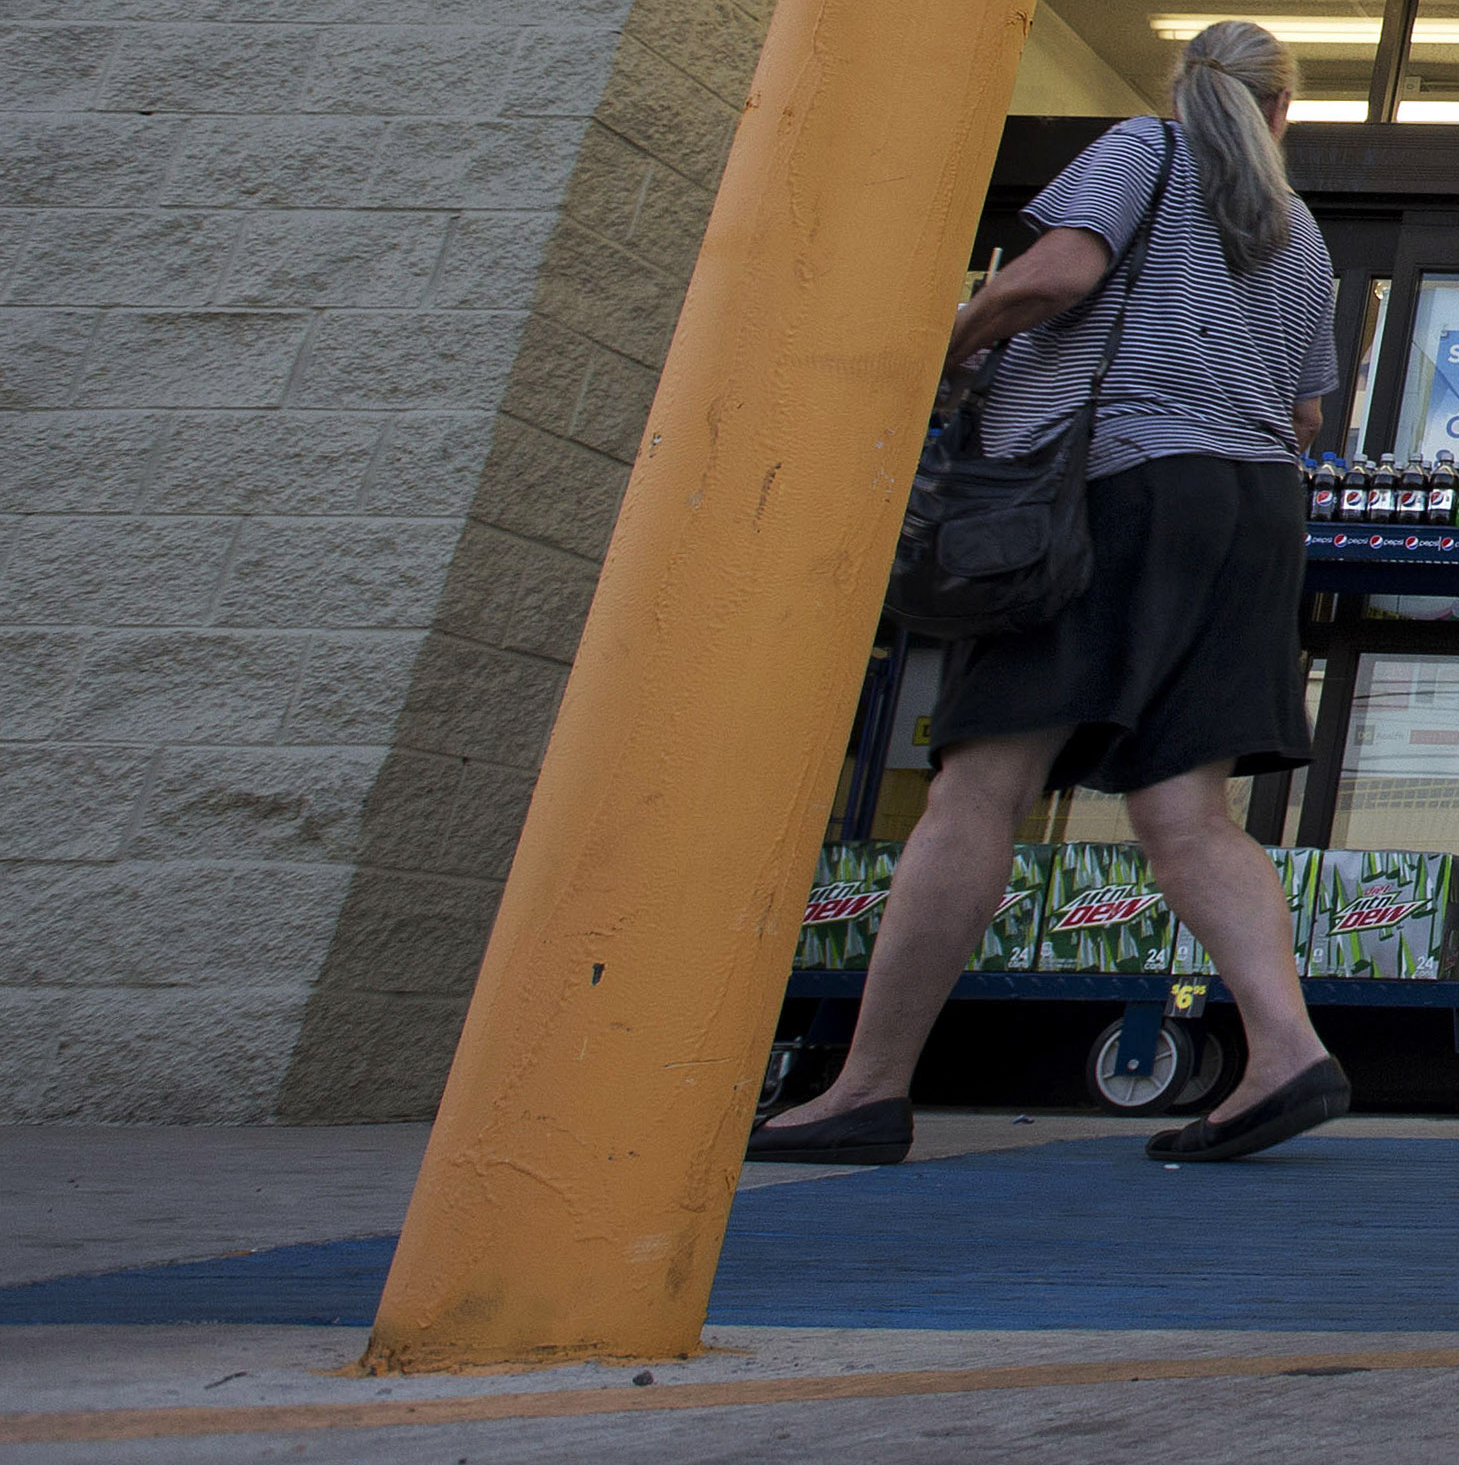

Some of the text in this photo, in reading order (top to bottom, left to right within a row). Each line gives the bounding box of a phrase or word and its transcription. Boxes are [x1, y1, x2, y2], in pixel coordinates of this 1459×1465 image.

[1363, 885, 1391, 896] diet
[1011, 947, 1029, 961] 24
[1147, 949, 1165, 963] 24
[1417, 956, 1433, 969] 24
